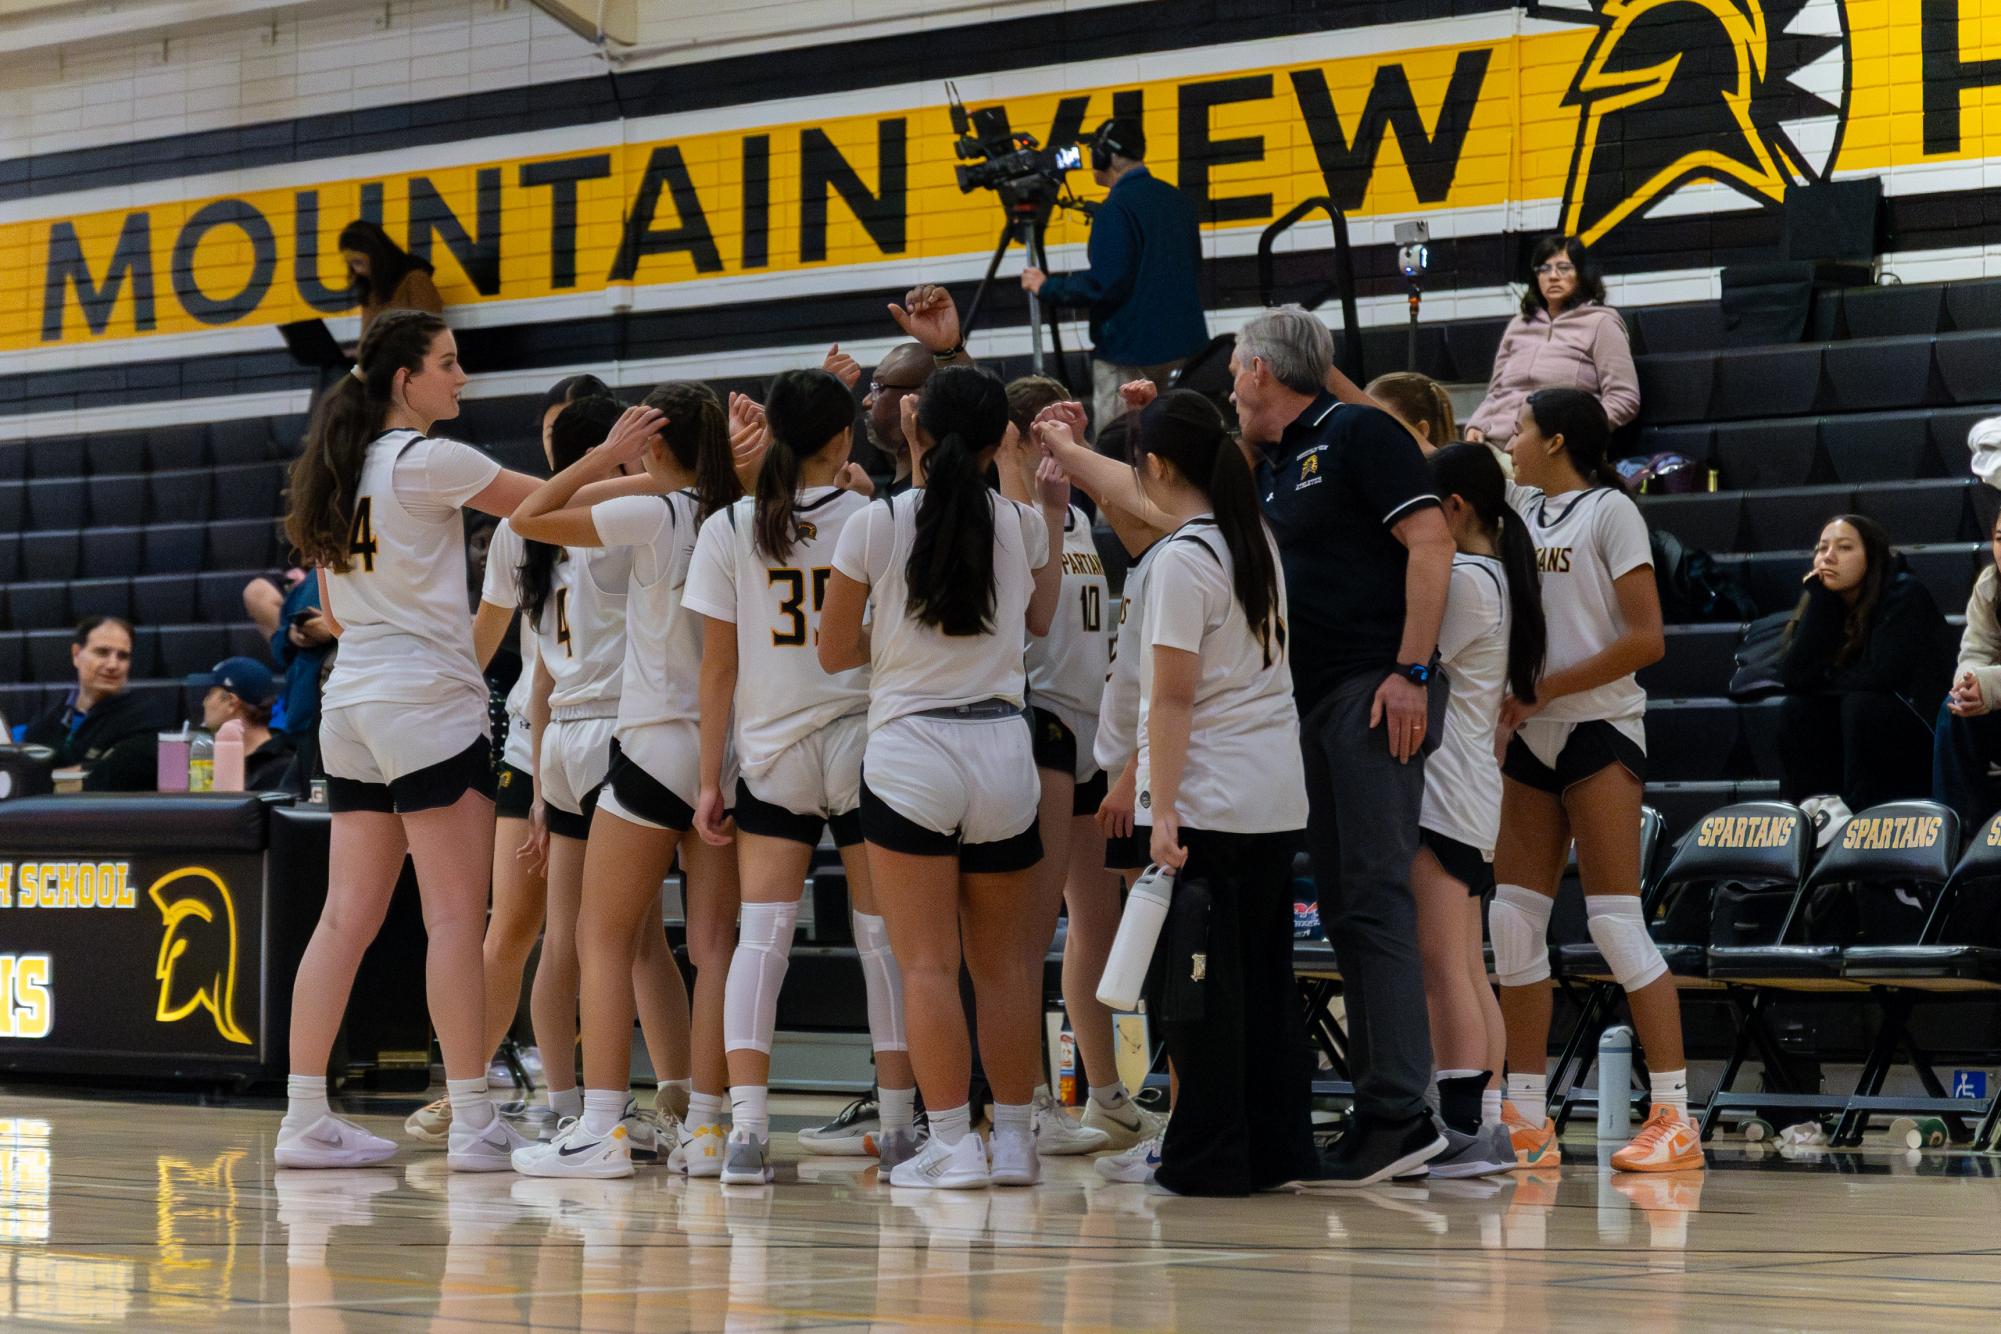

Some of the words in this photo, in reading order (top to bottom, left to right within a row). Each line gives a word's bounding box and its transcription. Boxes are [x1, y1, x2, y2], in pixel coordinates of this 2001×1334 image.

[41, 117, 907, 342] MOUNTAIN
[971, 48, 1493, 243] VEW
[1536, 547, 1572, 572] ANS
[1080, 584, 1101, 632] 10
[1698, 816, 1797, 848] SPARTANS
[1842, 816, 1943, 850] SPARTANS
[18, 863, 137, 909] SCHOOL
